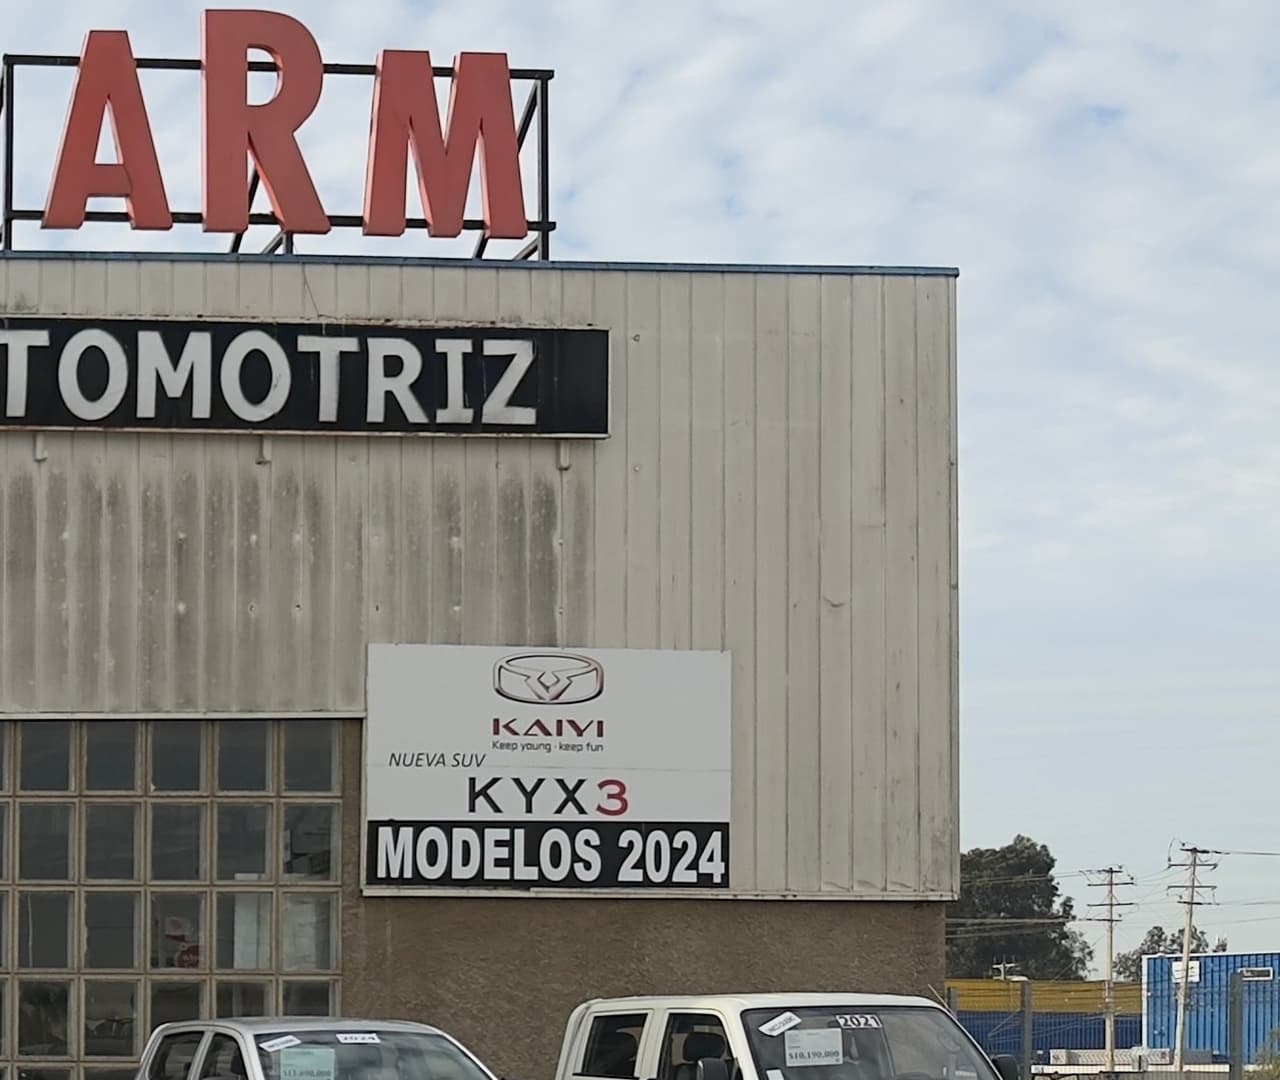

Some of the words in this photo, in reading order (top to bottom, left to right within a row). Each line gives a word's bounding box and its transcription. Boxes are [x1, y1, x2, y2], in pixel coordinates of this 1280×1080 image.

[40, 8, 528, 240] ARM
[492, 718, 604, 738] KAIYI
[492, 740, 517, 751] Keep
[520, 741, 552, 753] young
[558, 741, 582, 753] keep
[585, 741, 604, 752] fun
[388, 752, 447, 768] NUEVA
[450, 752, 487, 768] SUV
[467, 776, 629, 816] KYX3
[376, 825, 602, 882] MODELOS
[617, 829, 726, 884] 2024
[838, 1015, 880, 1027] 2021
